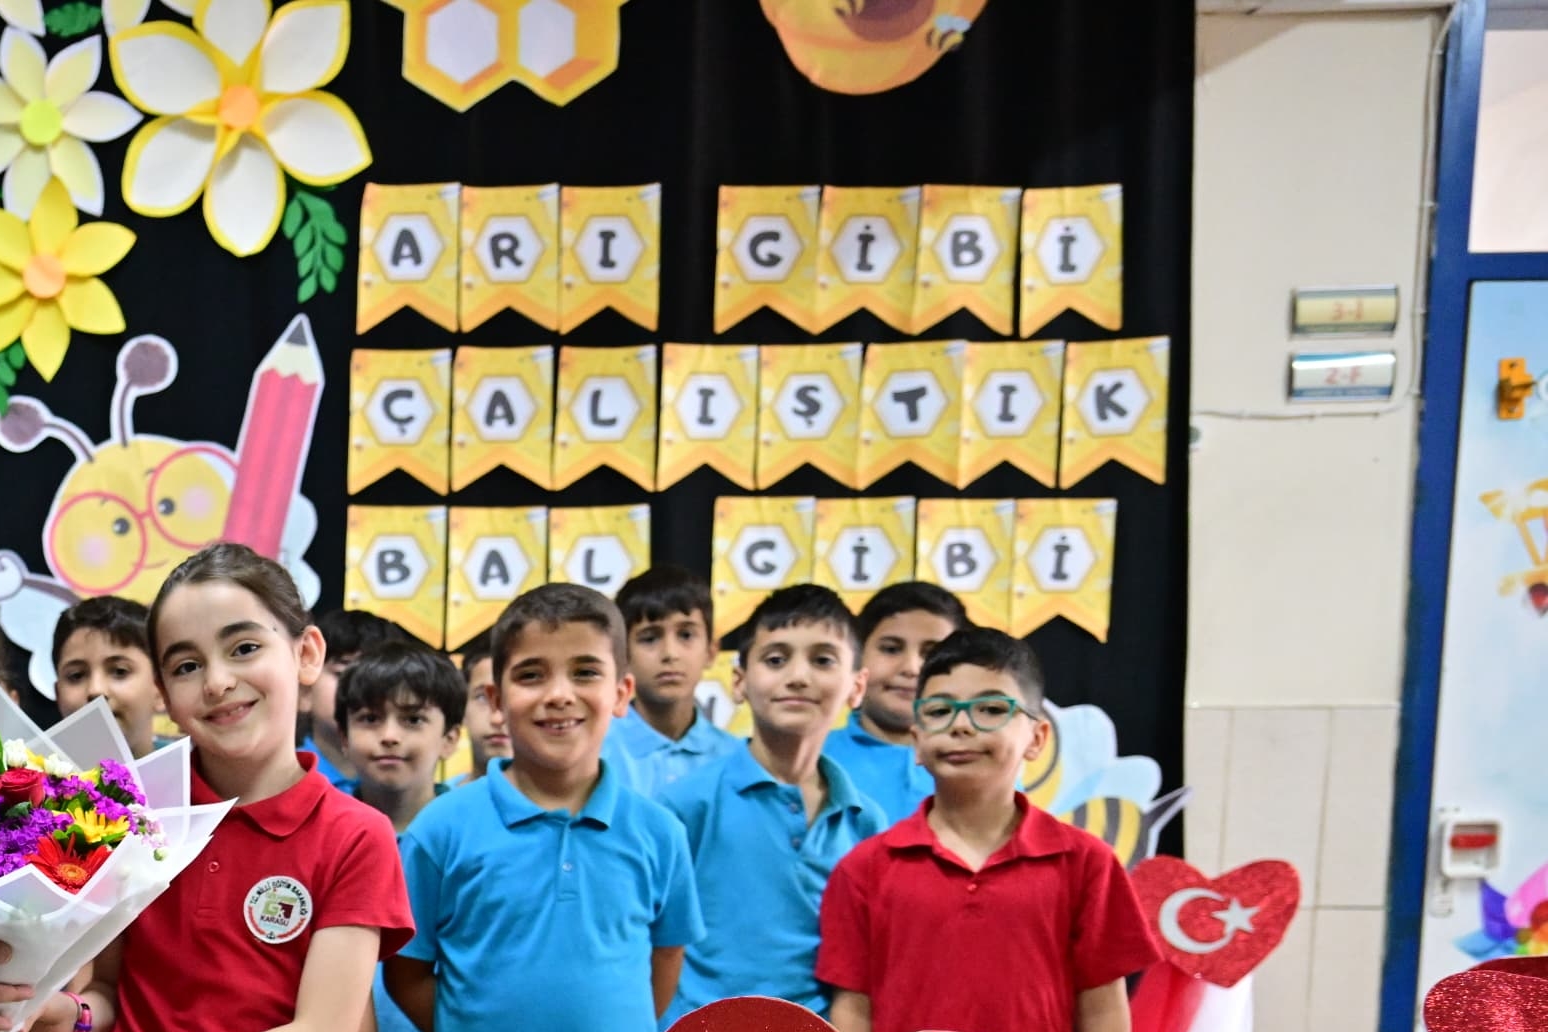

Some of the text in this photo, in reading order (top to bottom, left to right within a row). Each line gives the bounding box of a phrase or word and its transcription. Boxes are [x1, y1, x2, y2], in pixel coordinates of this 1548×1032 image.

[390, 224, 1078, 273] ARI GİBİ
[382, 382, 1129, 435] ÇALIŞTIK
[378, 538, 1072, 586] BAL GİBİ
[260, 914, 290, 926] KARASU
